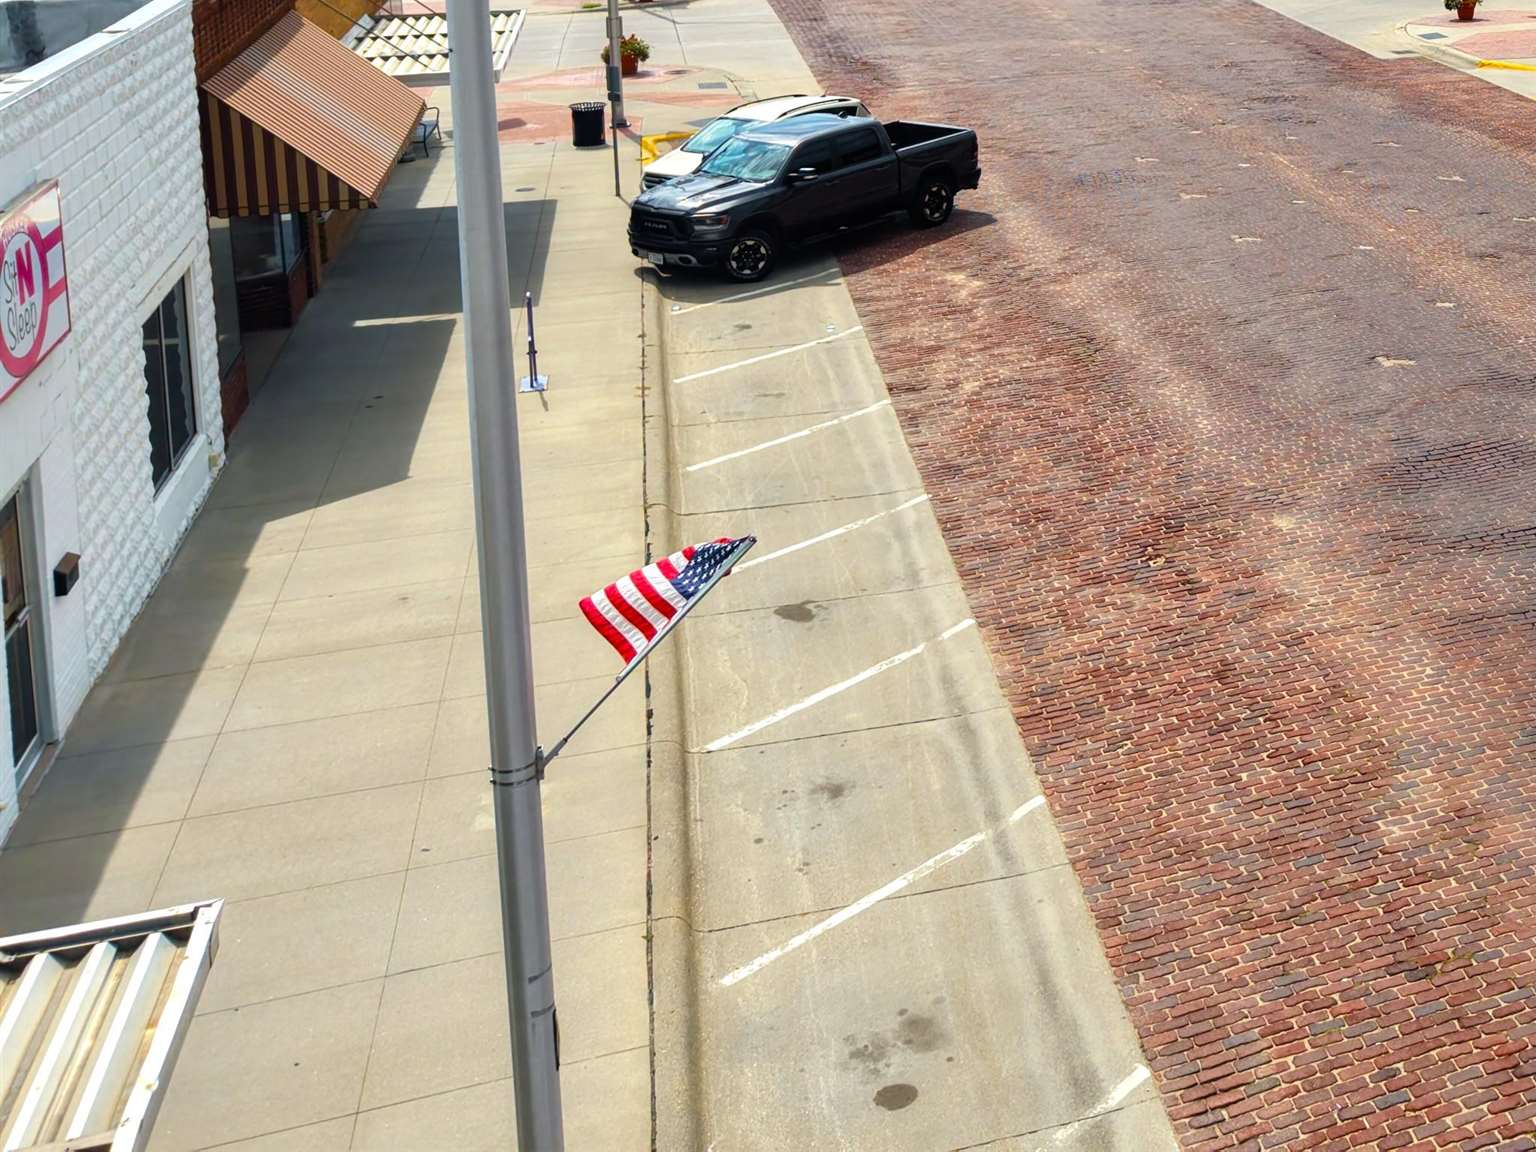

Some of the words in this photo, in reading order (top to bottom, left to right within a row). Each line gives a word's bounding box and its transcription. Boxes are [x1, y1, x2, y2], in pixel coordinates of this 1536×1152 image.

[3, 257, 18, 305] Sit
[15, 239, 35, 306] N
[7, 301, 38, 351] Sleep
